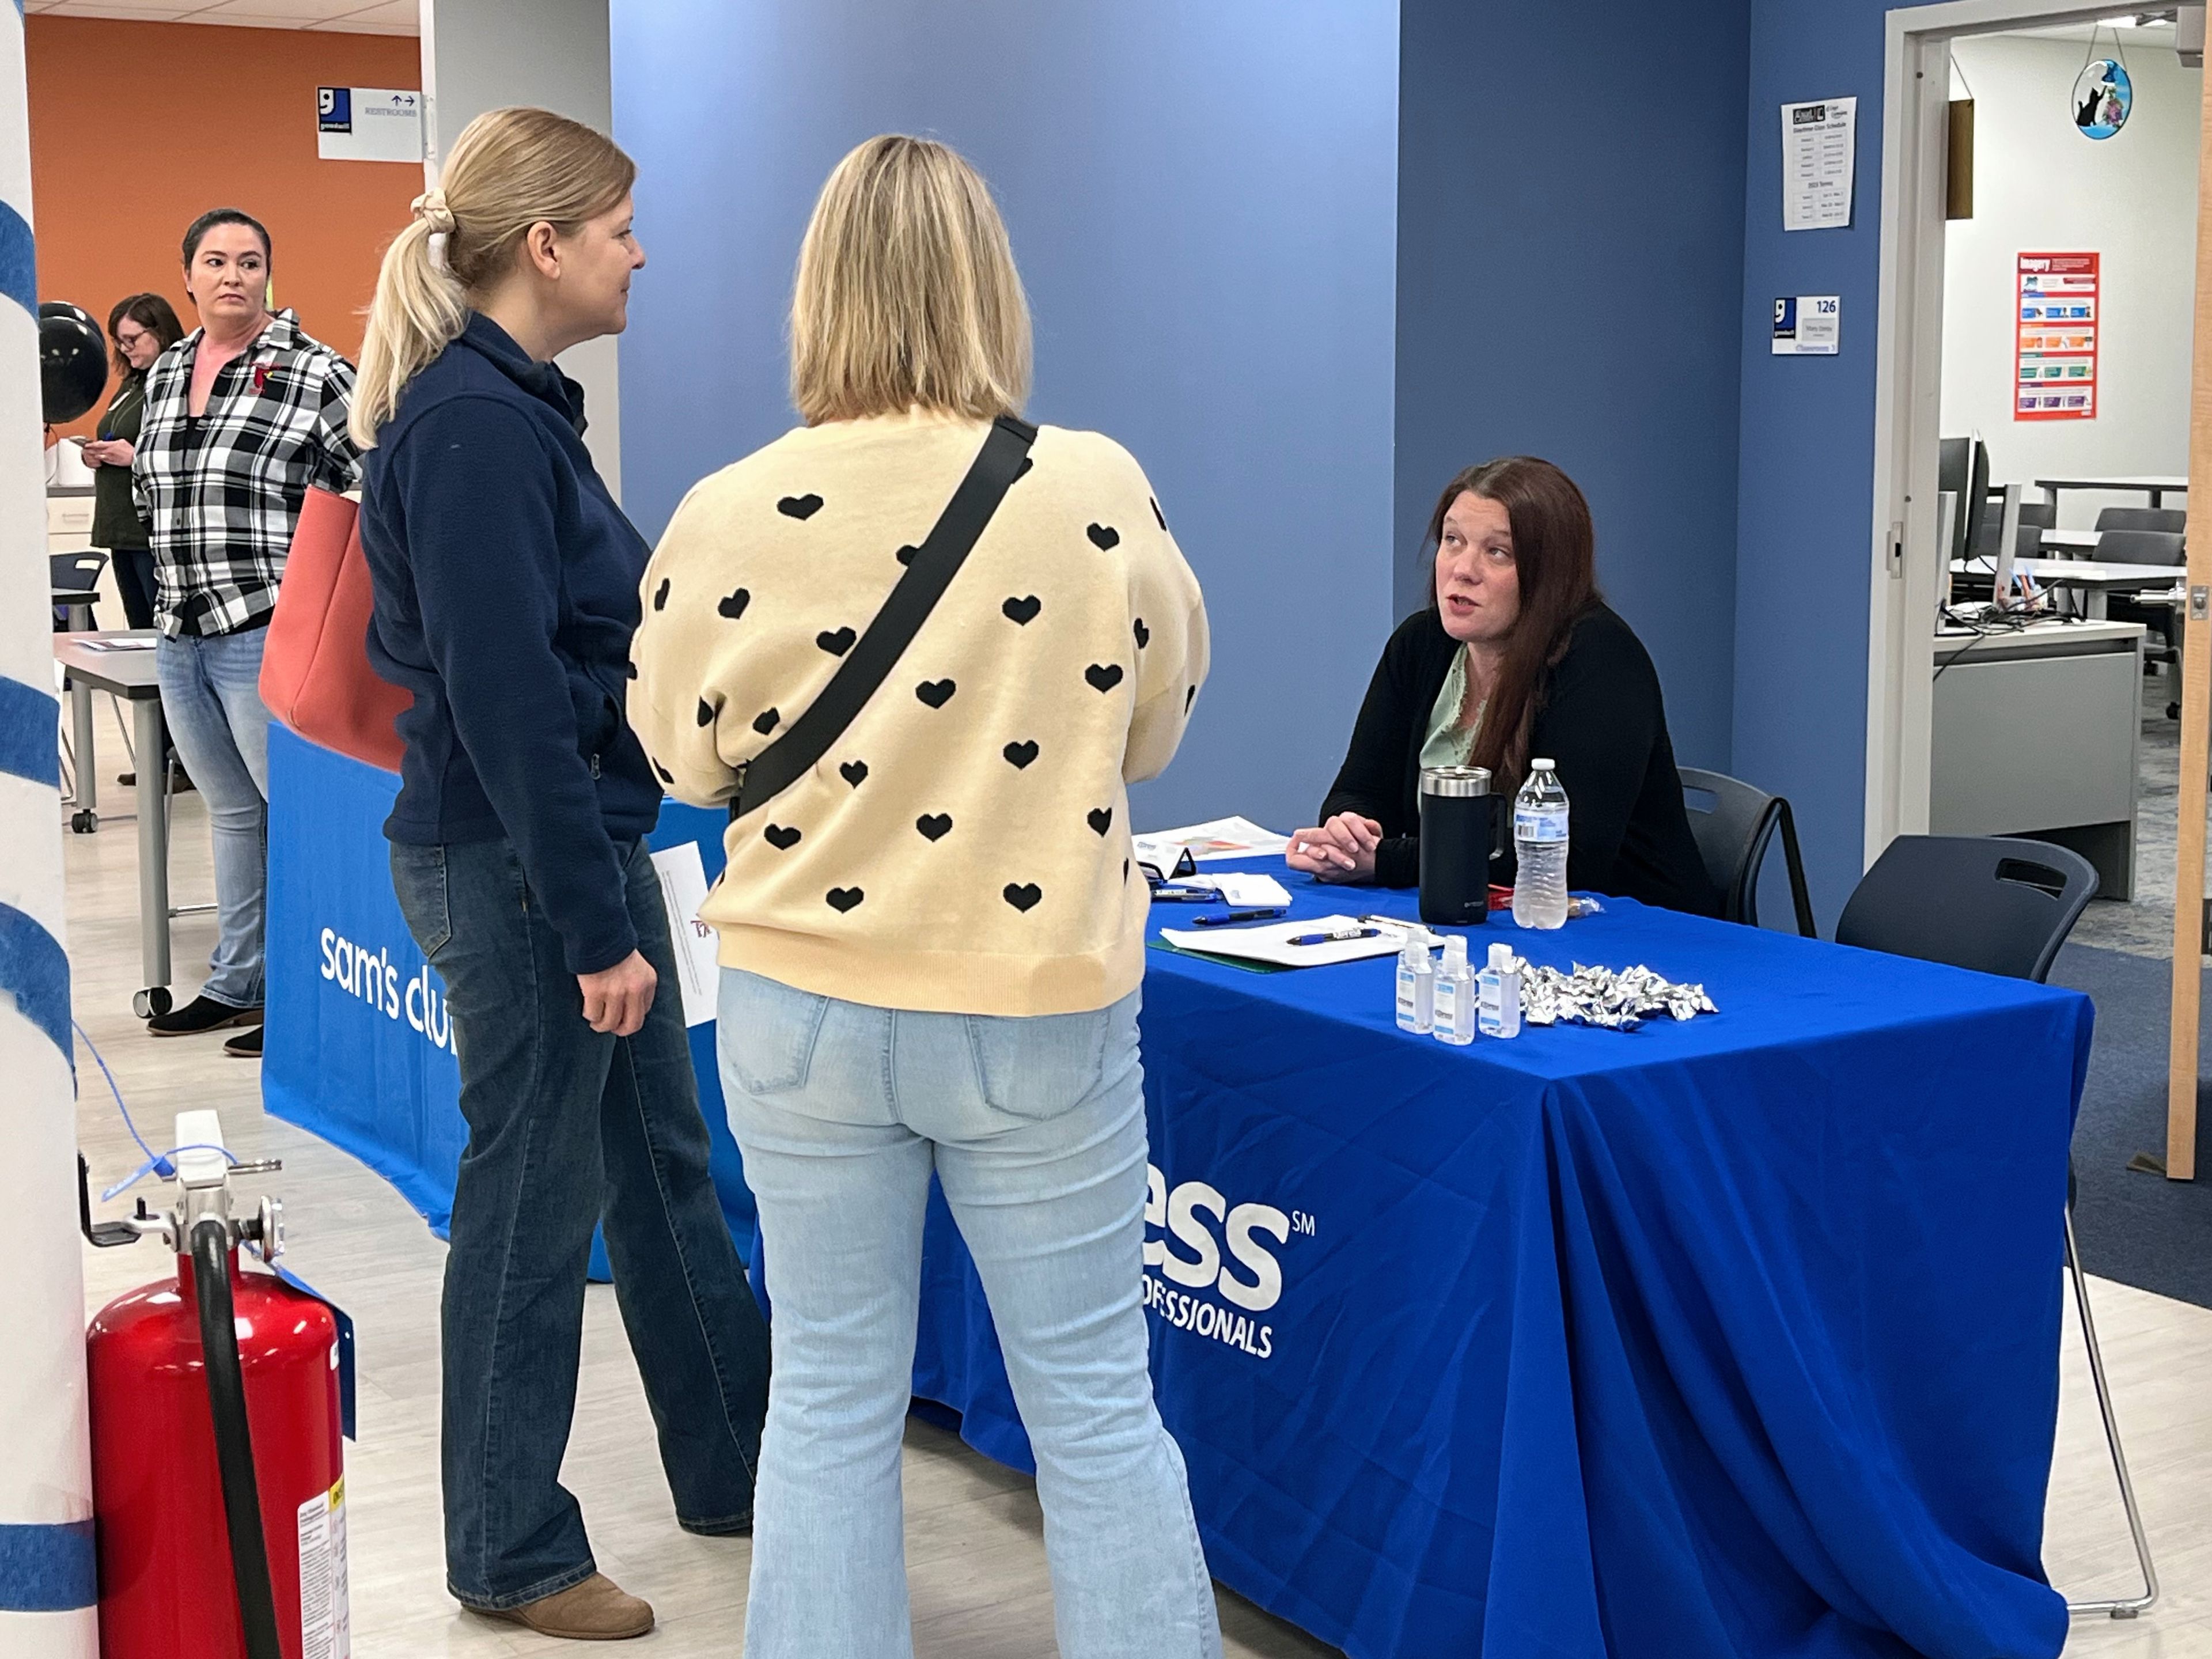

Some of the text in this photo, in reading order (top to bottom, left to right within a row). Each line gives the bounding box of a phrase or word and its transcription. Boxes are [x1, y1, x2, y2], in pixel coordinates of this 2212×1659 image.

[365, 107, 417, 117] RESTROOMS
[1817, 300, 1836, 313] 126
[321, 927, 399, 1020] sam's
[1292, 1210, 1315, 1237] SM
